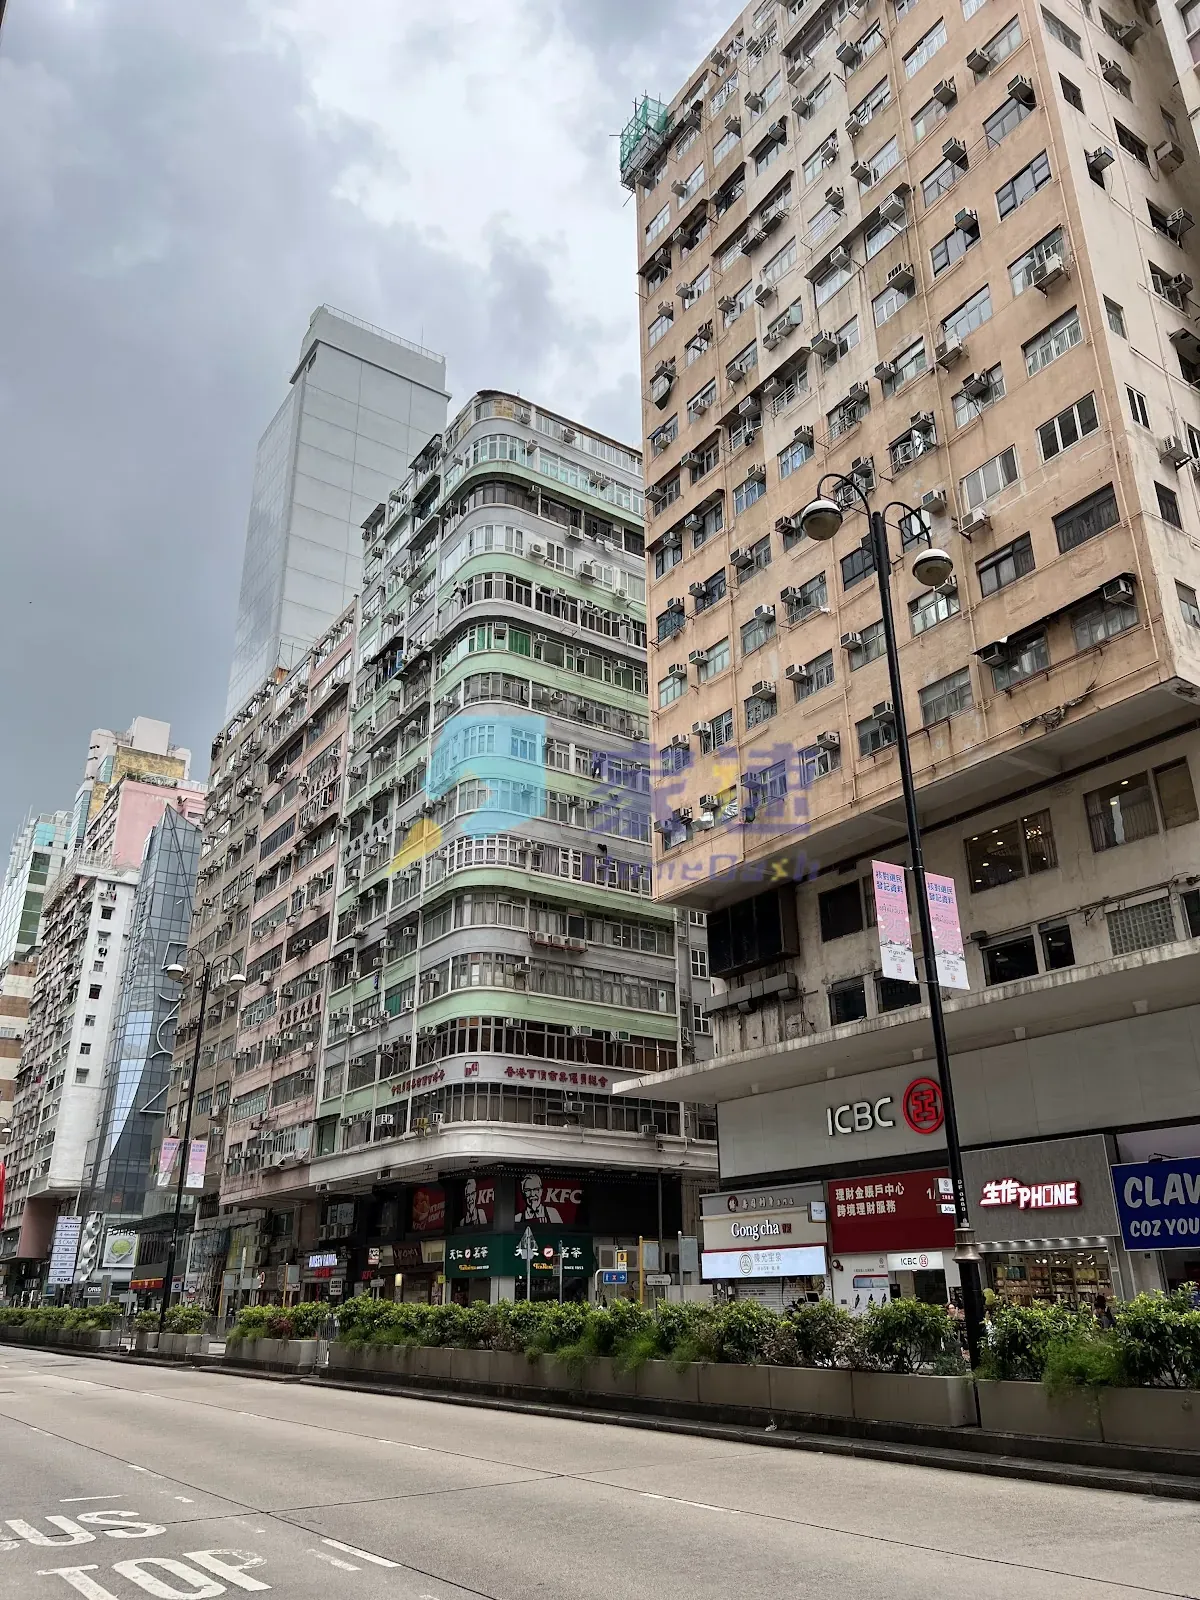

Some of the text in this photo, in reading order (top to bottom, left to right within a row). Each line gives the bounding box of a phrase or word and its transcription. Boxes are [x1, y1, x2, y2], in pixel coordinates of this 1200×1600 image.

[826, 1097, 895, 1136] ICBC
[544, 1187, 583, 1204] KFC
[835, 1182, 905, 1201] 理財金賬戶中心
[836, 1200, 896, 1218] 跨境理財服務
[731, 1222, 760, 1241] Gong
[760, 1219, 780, 1235] cha
[1130, 1217, 1200, 1238] COZ YOU
[900, 1257, 918, 1266] ICBC
